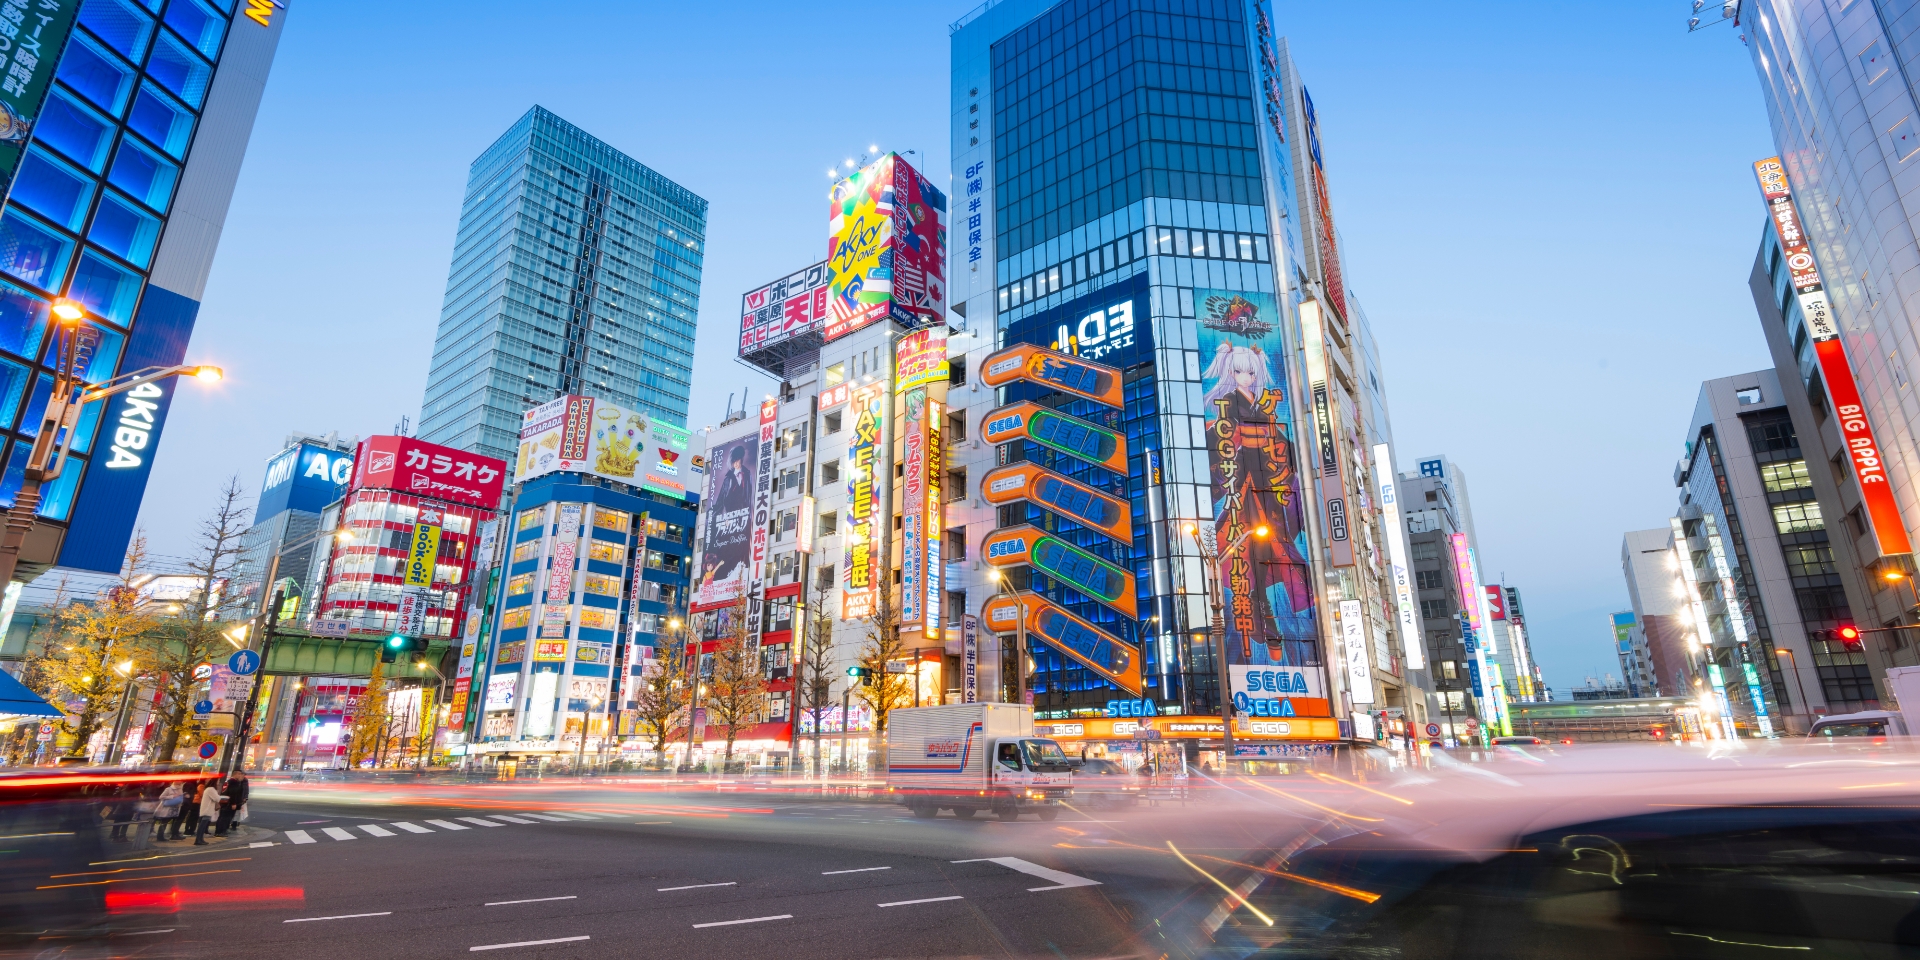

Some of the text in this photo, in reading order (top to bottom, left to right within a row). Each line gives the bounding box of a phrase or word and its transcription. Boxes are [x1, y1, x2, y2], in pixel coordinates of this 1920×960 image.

[966, 161, 983, 178] 8F
[1760, 163, 1786, 193] 北海道
[833, 215, 884, 273] AKKY
[858, 244, 878, 262] ONE
[771, 265, 827, 302] ボーク
[1796, 278, 1821, 287] MARU
[743, 303, 783, 330] 秋葉原
[741, 325, 781, 347] ホビー
[821, 385, 846, 408] 免税
[105, 375, 163, 468] AKIBA
[523, 416, 563, 438] TAKARADA
[564, 401, 578, 458] AKIHABARA
[574, 398, 591, 459] WELCOME TO
[653, 426, 670, 436] DUTY
[988, 414, 1024, 436] SEGA
[1040, 417, 1100, 457] SEGA
[1258, 388, 1291, 507] ゲーセンで
[1839, 404, 1884, 484] BIG APPLE
[404, 449, 499, 484] カラオケ
[853, 390, 876, 520] TAX FREE
[907, 434, 922, 495] ラムタラ
[1041, 479, 1105, 521] SEGA
[421, 508, 440, 523] 本
[929, 501, 939, 535] DVD
[1327, 498, 1349, 541] GiGO
[989, 538, 1026, 558] SEGA
[548, 542, 567, 600] まんが喫茶
[559, 542, 576, 599] インターネット
[632, 558, 641, 600] TAKARADA
[1044, 545, 1107, 597] SEGA
[846, 594, 873, 607] AKKY
[849, 605, 870, 617] ONE
[315, 621, 347, 631] 万世橋
[398, 596, 414, 634] 徒歩3分
[965, 621, 976, 630] 8F
[1048, 613, 1112, 666] SEGA
[1462, 621, 1476, 654] ALINCO
[1246, 670, 1309, 693] SEGA
[1107, 699, 1158, 718] SEGA
[1247, 698, 1296, 717] SEGA
[1052, 723, 1084, 736] GiGO
[1113, 722, 1144, 735] GiG
[1251, 722, 1291, 734] GiGO
[928, 742, 960, 753] ゆうパック
